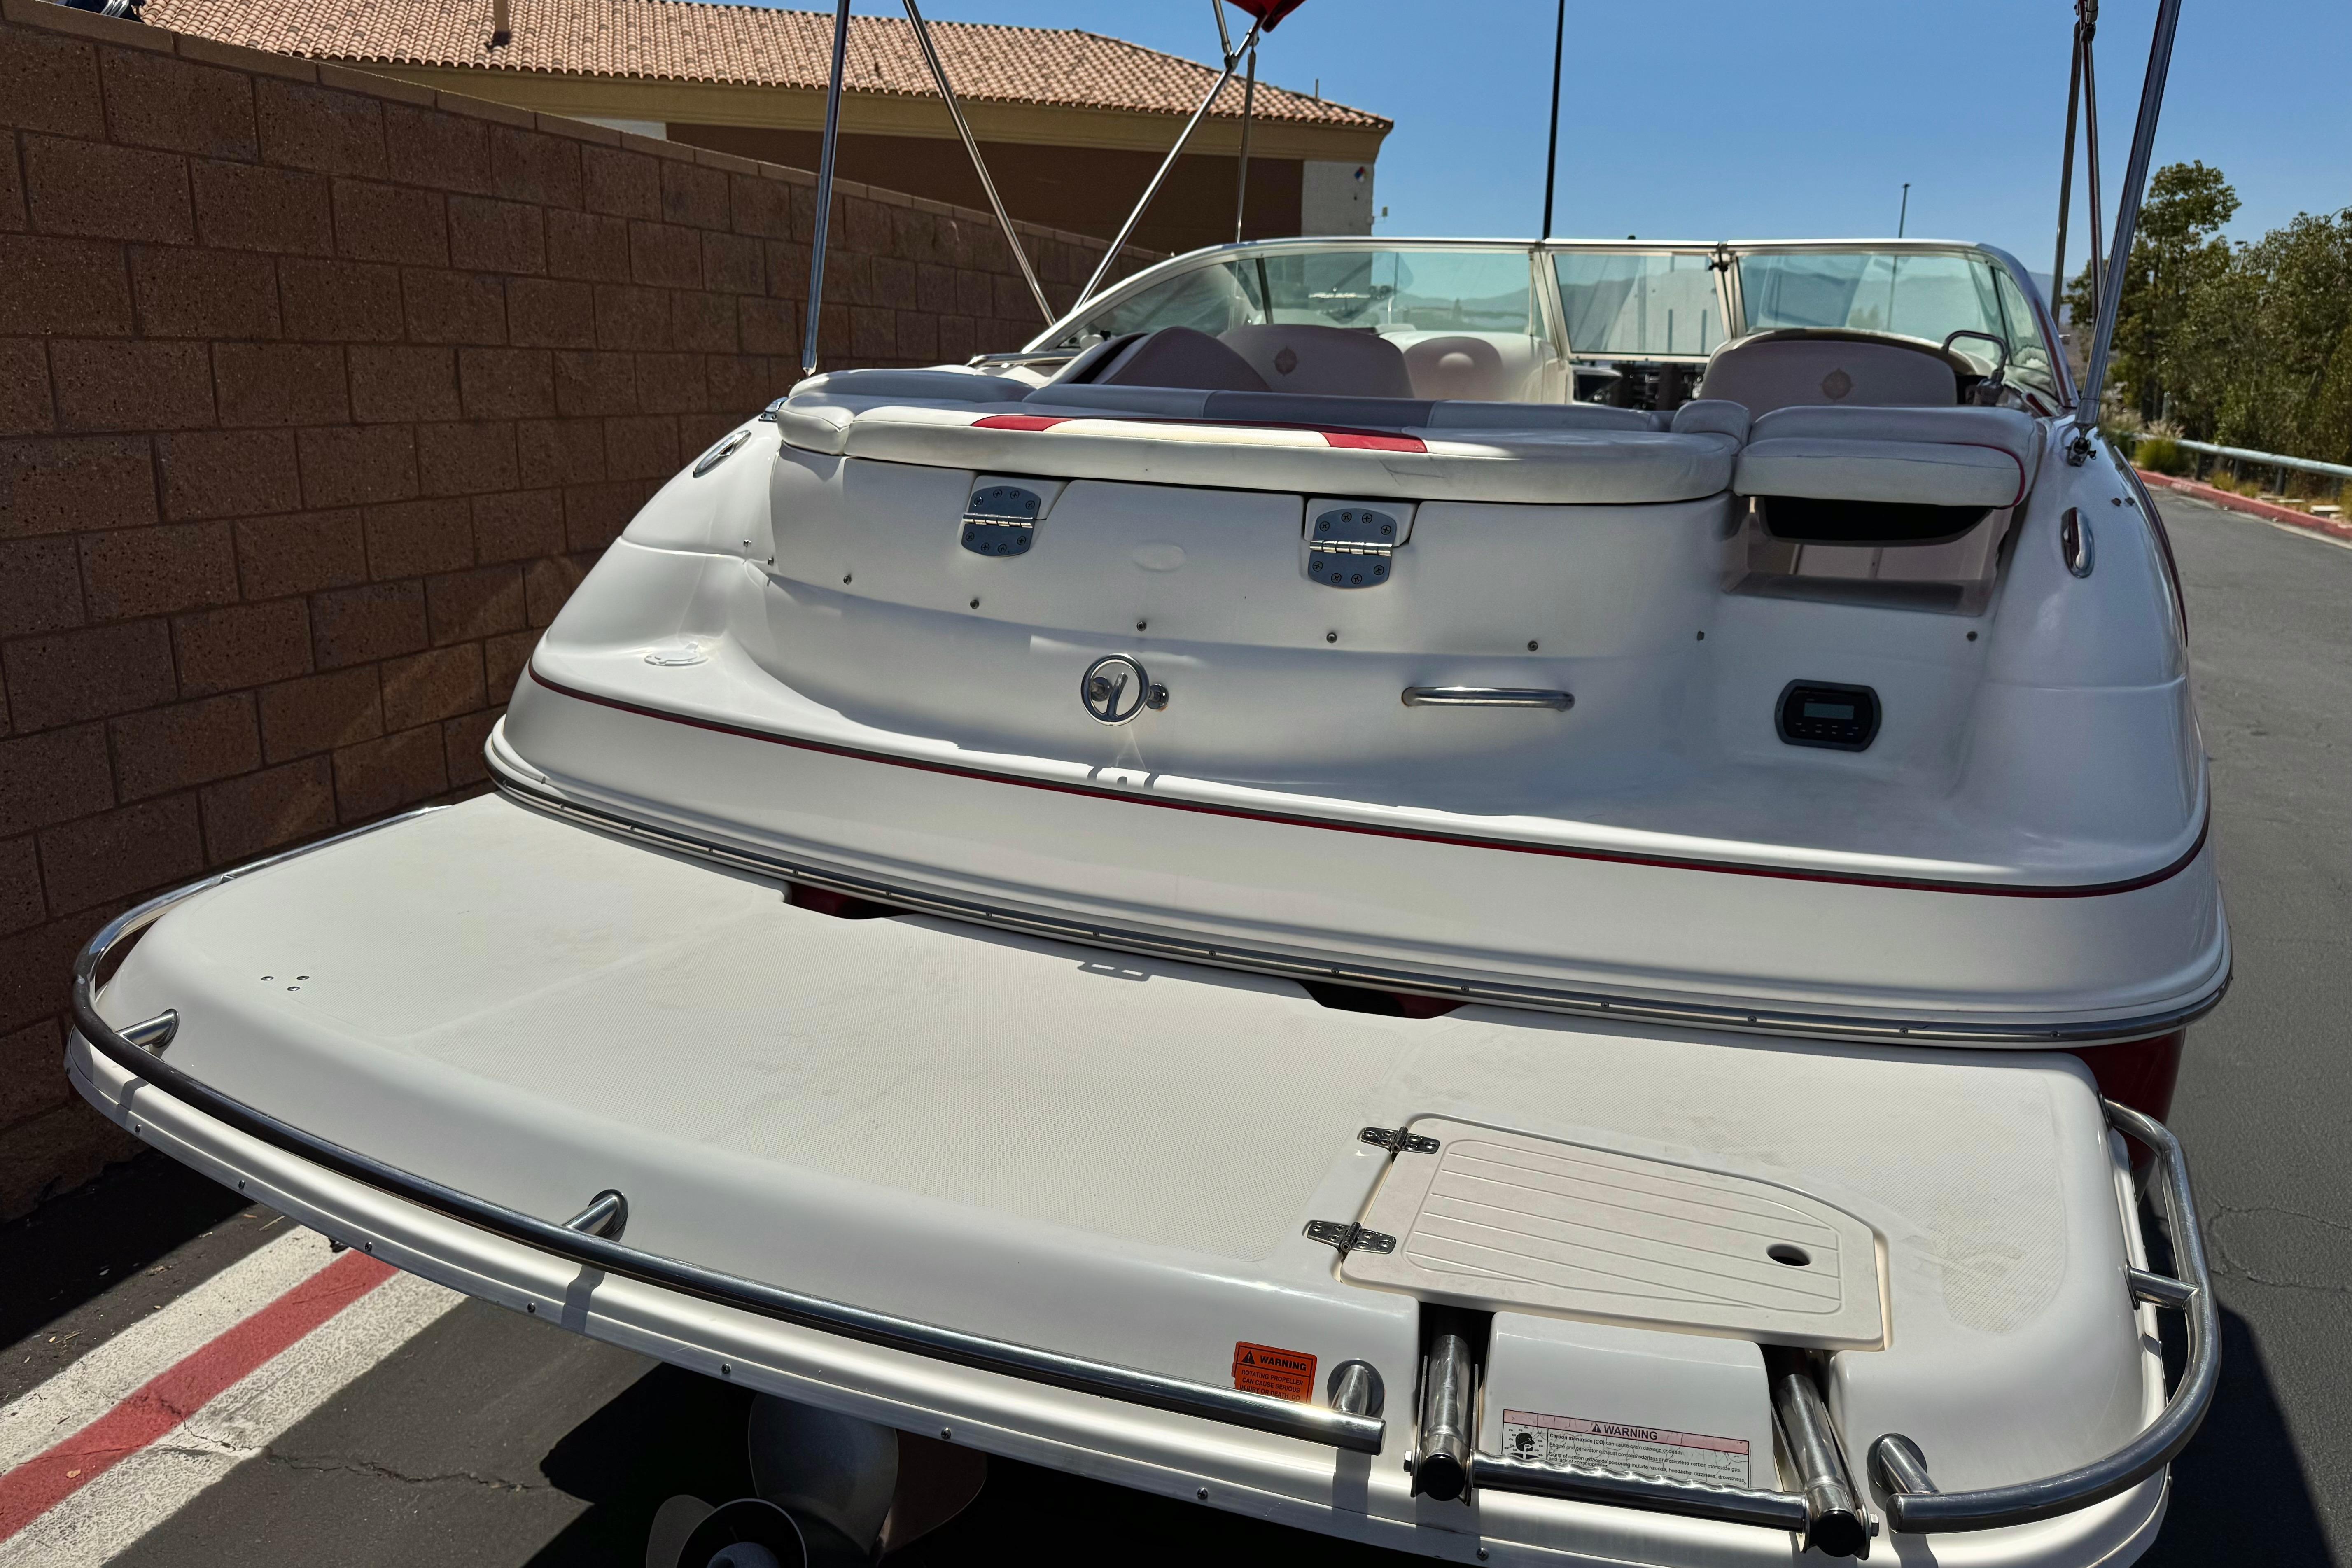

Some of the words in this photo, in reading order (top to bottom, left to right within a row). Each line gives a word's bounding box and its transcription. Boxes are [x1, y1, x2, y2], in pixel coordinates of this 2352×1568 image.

[1260, 1355, 1306, 1371] WARNING
[1241, 1370, 1269, 1379] ROTATING
[1270, 1374, 1303, 1386] PROPELLER
[1240, 1384, 1259, 1393] INJURY
[1256, 1380, 1274, 1388] CAUSE
[1275, 1384, 1300, 1393] SERIOUS
[1604, 1425, 1657, 1440] WARNING
[1669, 1468, 1693, 1476] headache,
